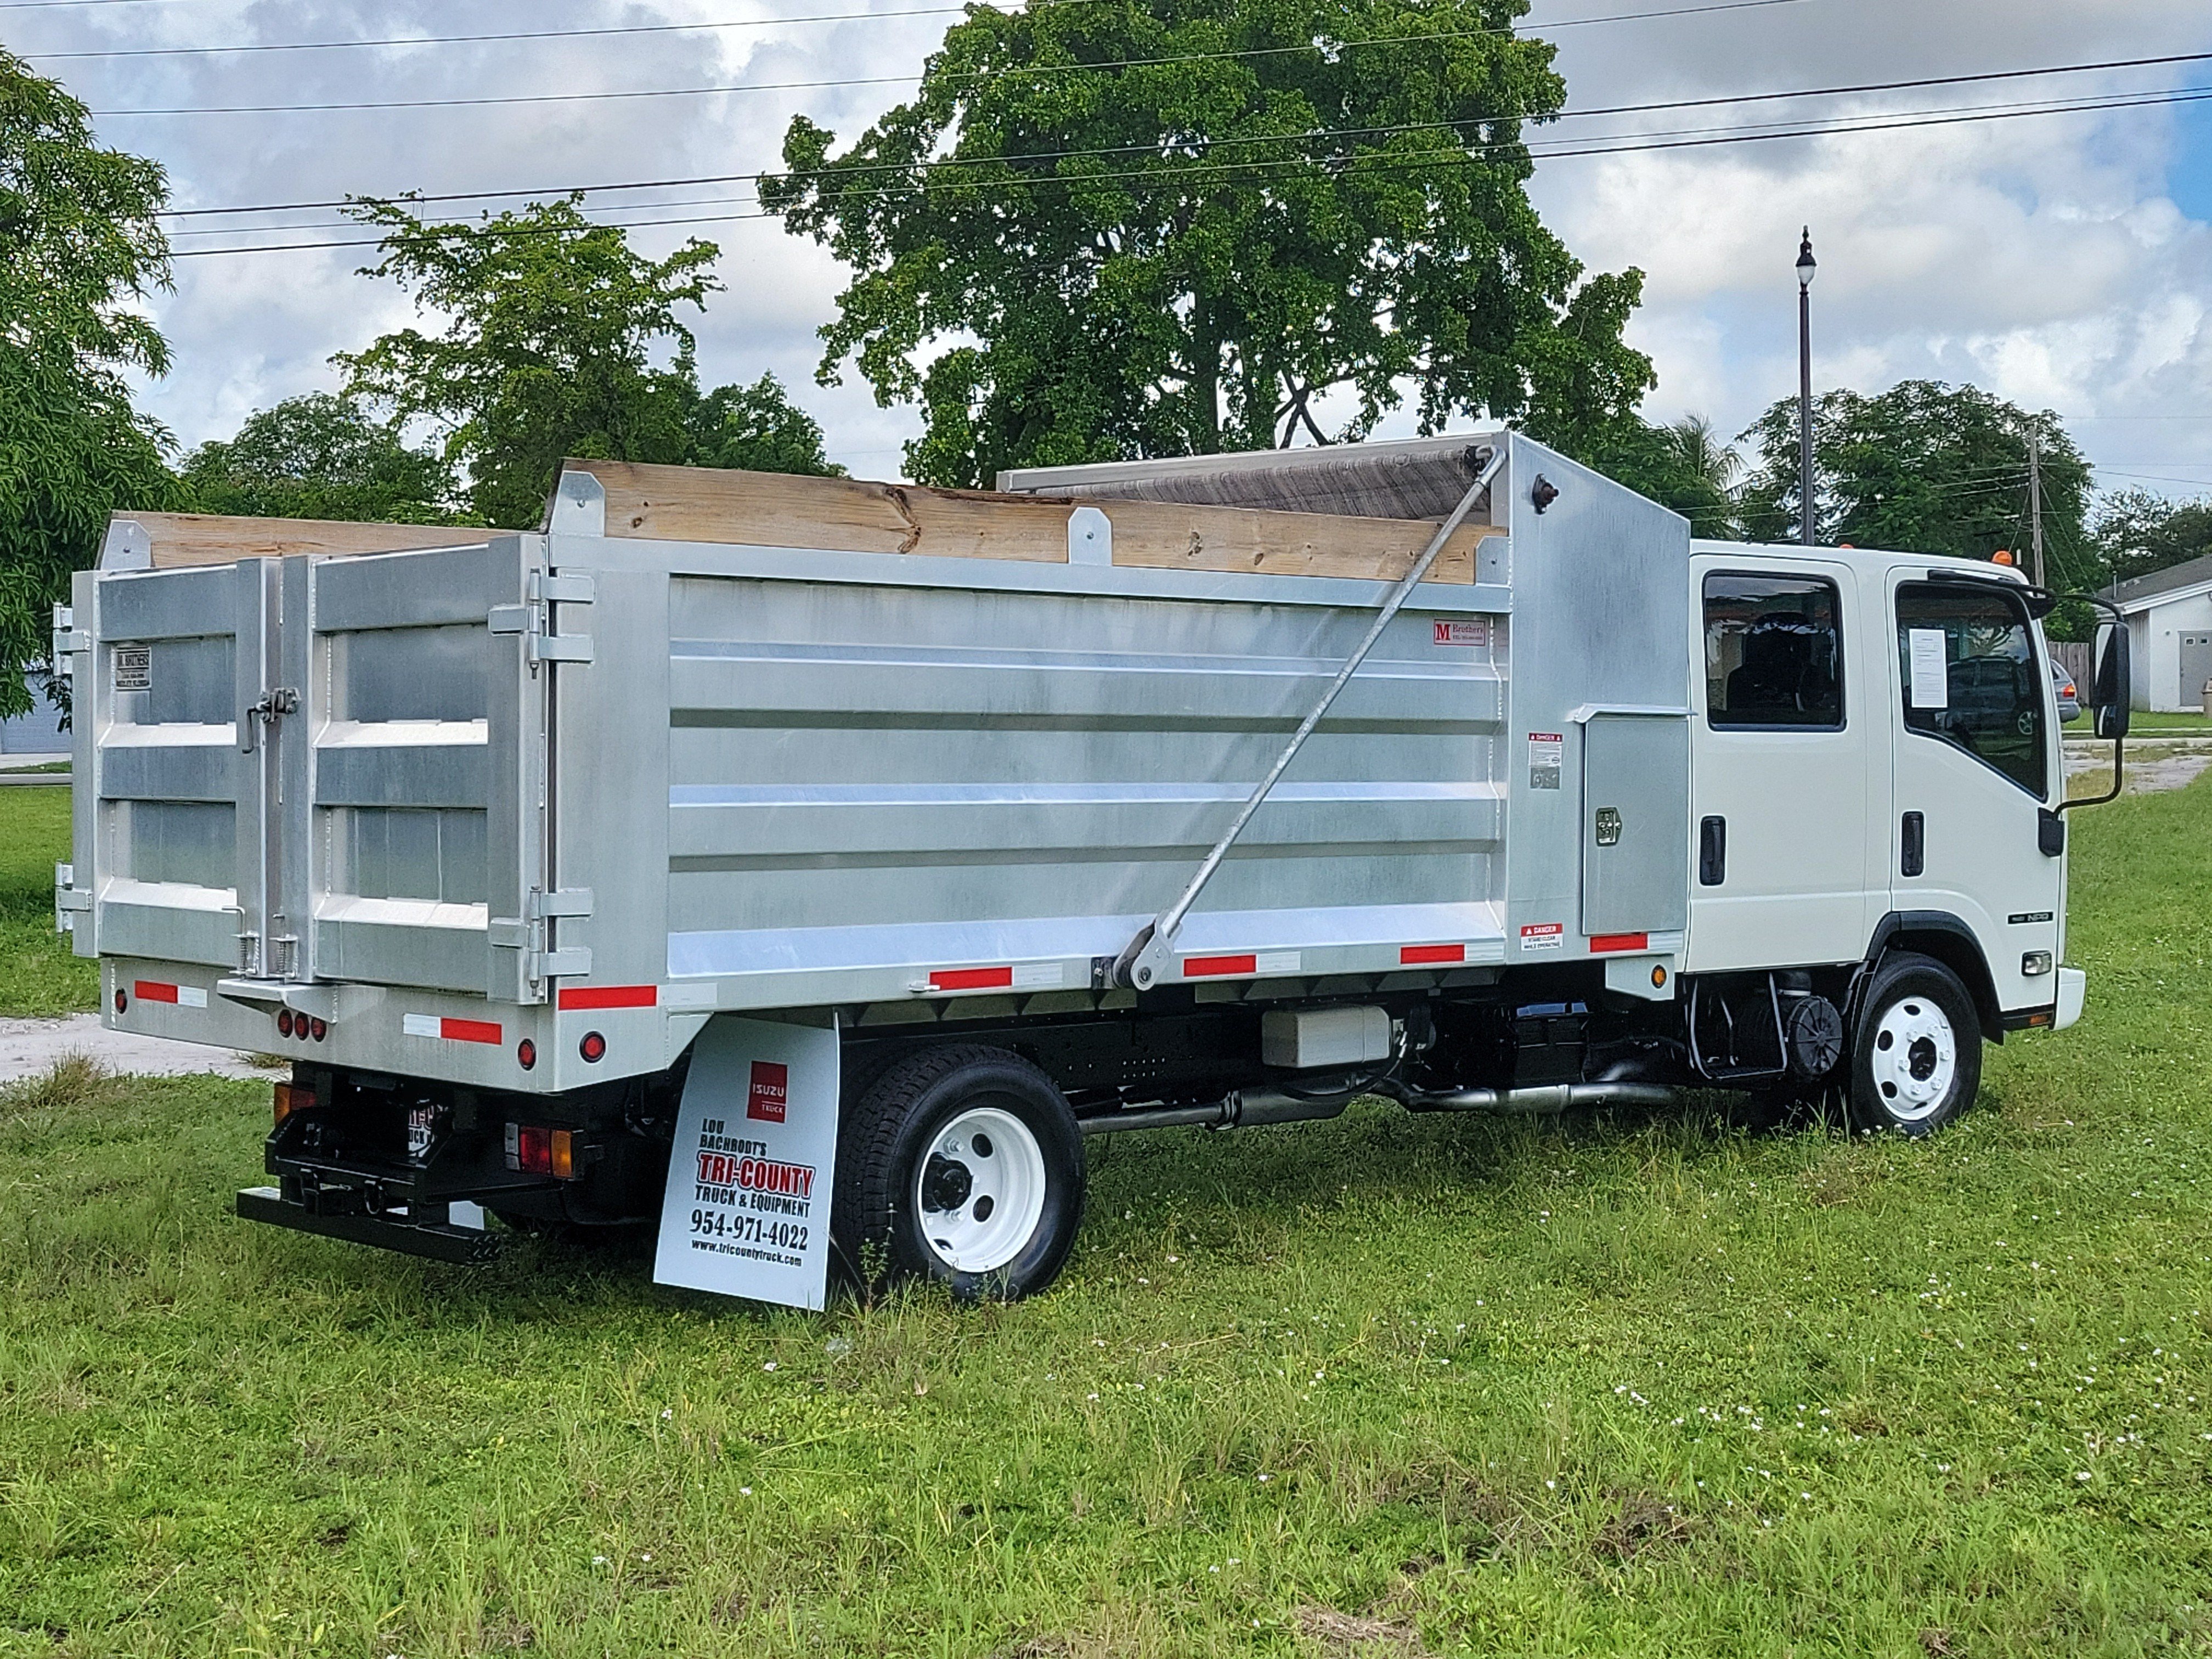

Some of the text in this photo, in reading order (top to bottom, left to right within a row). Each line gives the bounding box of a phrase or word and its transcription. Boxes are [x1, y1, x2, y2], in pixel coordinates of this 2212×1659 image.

[1436, 624, 1451, 640] M
[753, 1083, 784, 1097] ISUZU
[762, 1104, 783, 1114] TRUCK
[702, 1118, 725, 1134] LOU
[699, 1152, 814, 1197] TRI-COUNTY
[695, 1184, 810, 1218] TRUCK & EQUIPMENT
[689, 1209, 809, 1251] 954-971-4022
[691, 1239, 802, 1267] www.tricountytruck.com
